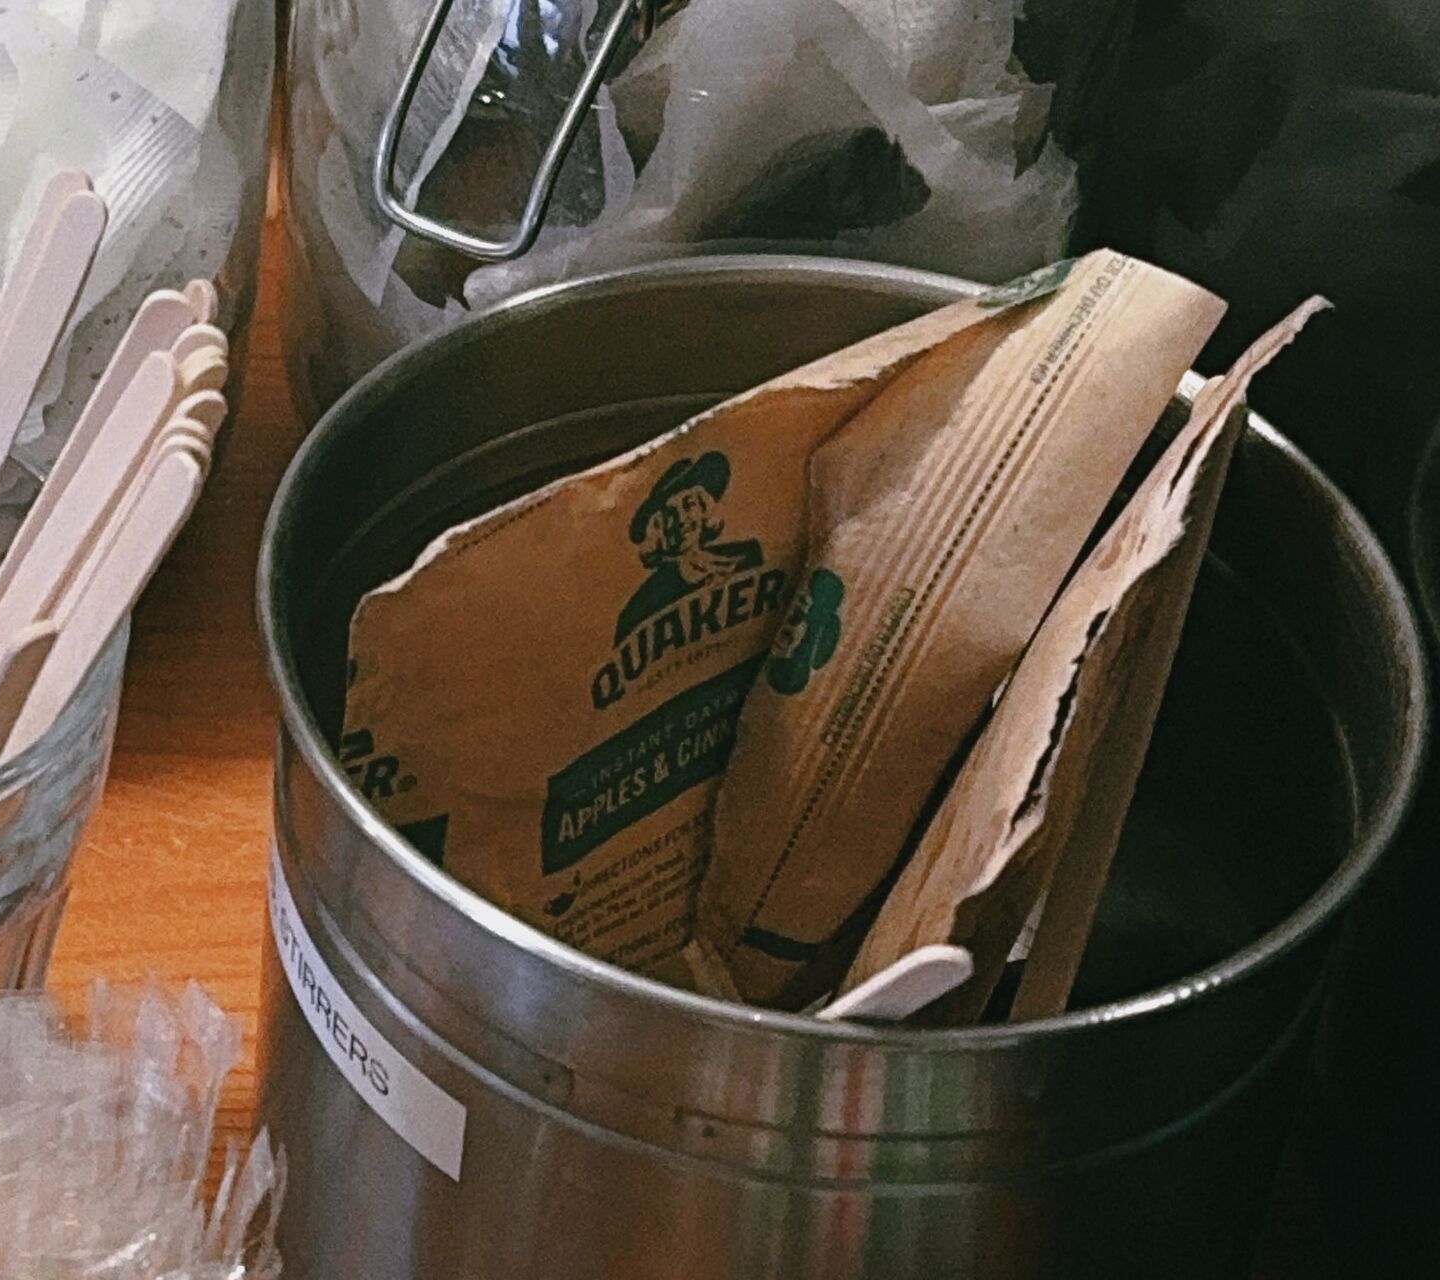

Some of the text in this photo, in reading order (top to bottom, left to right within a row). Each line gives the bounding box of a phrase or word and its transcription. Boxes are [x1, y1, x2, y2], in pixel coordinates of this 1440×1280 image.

[591, 569, 786, 711] QUAKER
[558, 767, 647, 843] APPLES
[279, 906, 390, 1097] STIRRERS
